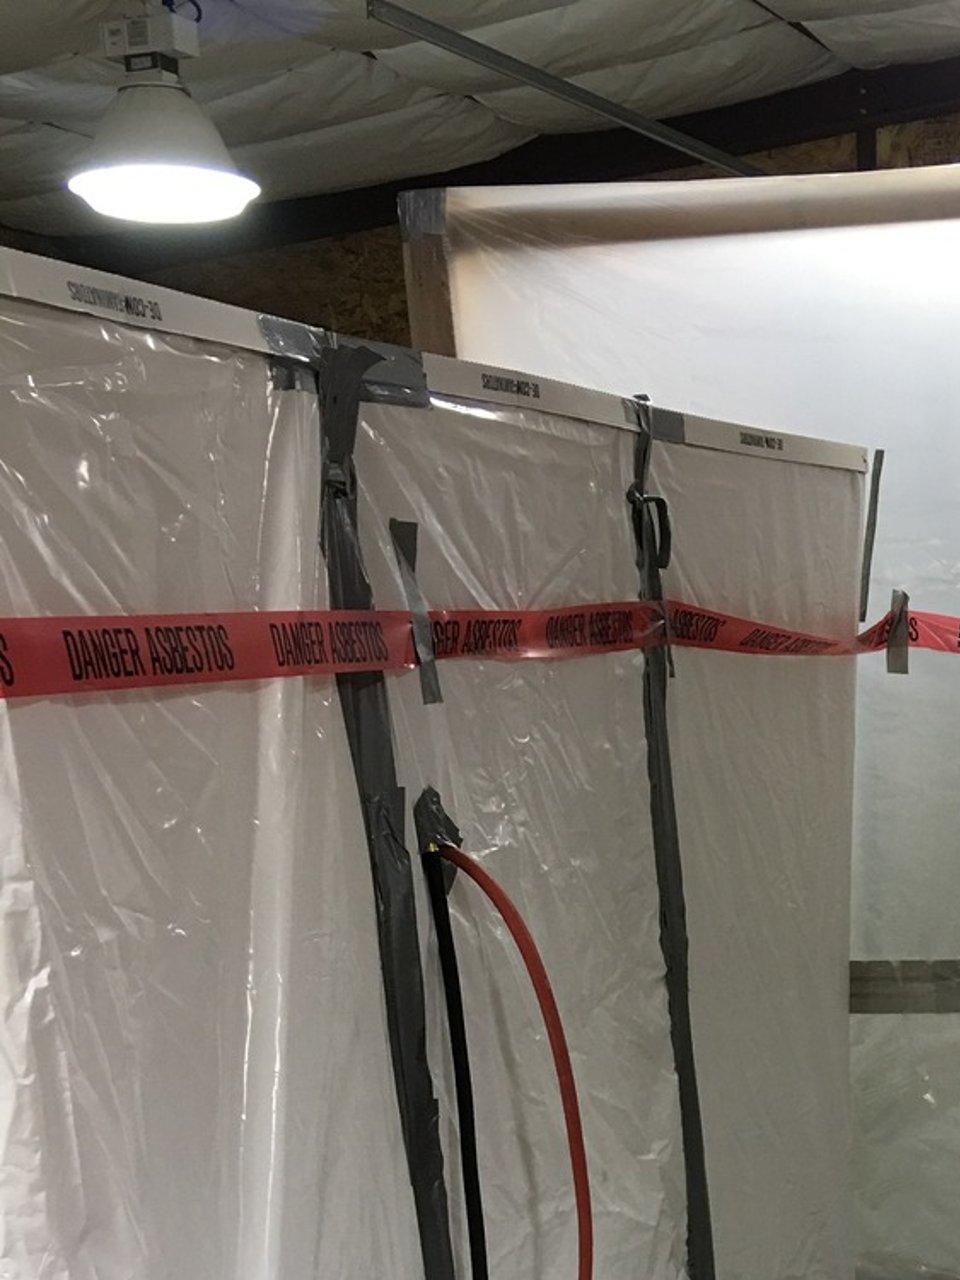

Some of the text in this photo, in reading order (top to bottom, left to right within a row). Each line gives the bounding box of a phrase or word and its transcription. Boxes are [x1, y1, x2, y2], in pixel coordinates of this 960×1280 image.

[269, 620, 389, 666] DANGER ASBESTOS
[546, 609, 634, 648] DANGER ASBESTOS
[62, 629, 146, 681] DANGER
[145, 624, 235, 676] ASBESTOS
